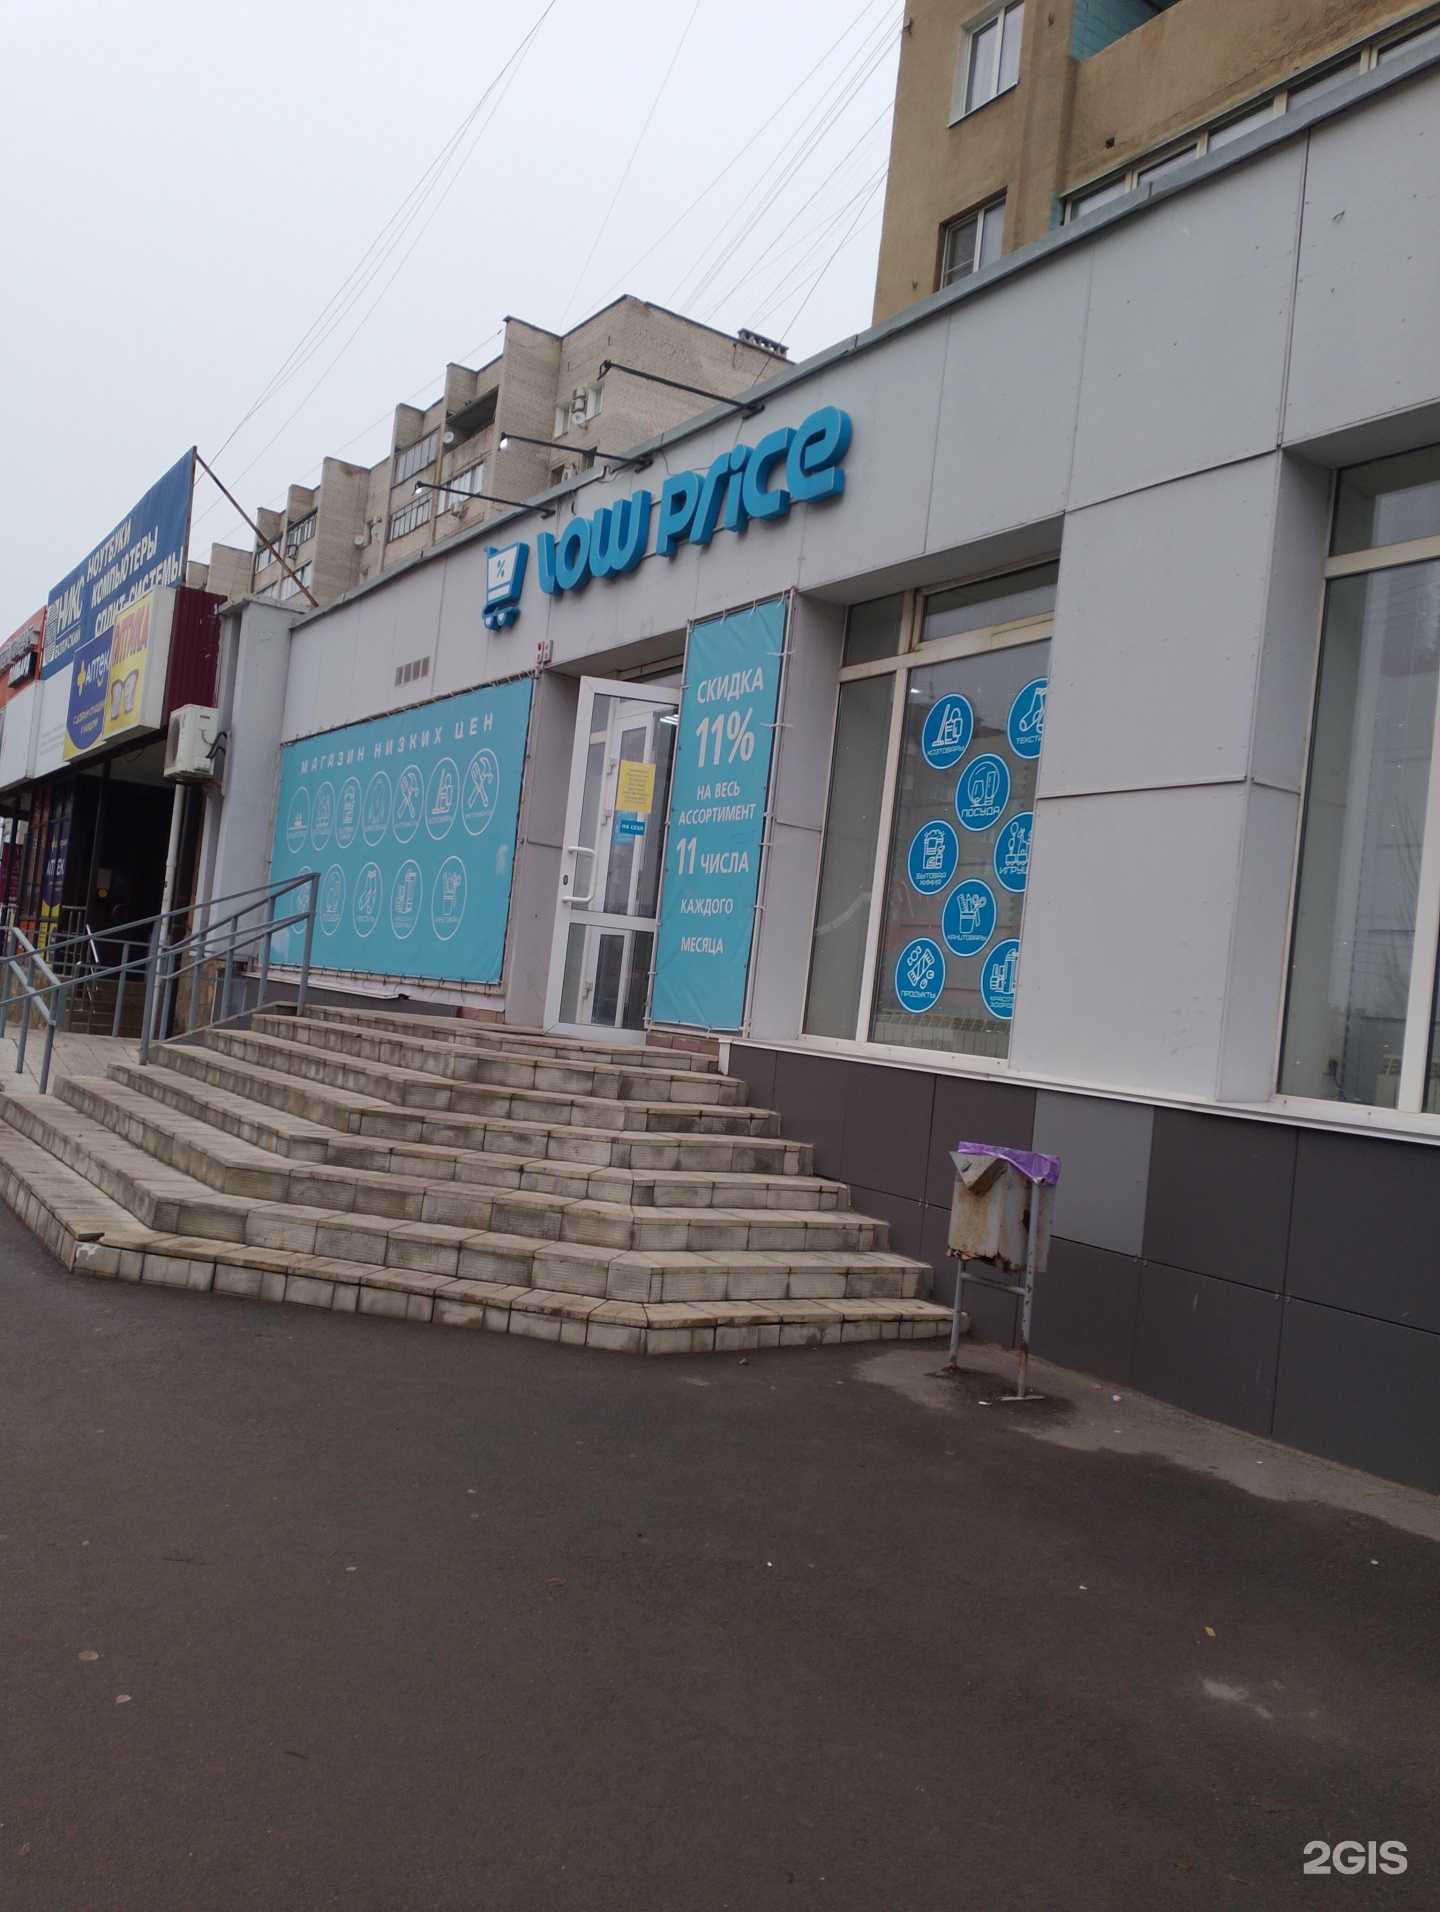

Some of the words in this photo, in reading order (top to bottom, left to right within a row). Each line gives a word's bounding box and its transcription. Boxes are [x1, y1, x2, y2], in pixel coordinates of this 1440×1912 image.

[92, 525, 159, 609] КОМПЬЮТЕРЫ
[697, 666, 765, 704] СКИДКА
[301, 747, 366, 774] МАГАЗИН
[374, 727, 443, 759] НИЗКИХ
[455, 712, 494, 739] ЦЕН
[695, 708, 755, 769] 11%
[1016, 734, 1041, 745] ТЕКСТ
[697, 785, 711, 800] НА
[714, 782, 740, 798] ВЕСЬ
[678, 803, 757, 826] АССОРТИМЕНТ
[961, 805, 1000, 818] ПОСУДА
[676, 837, 697, 876] 11
[700, 852, 749, 875] ЧИСЛА
[680, 898, 734, 916] КАЖДОГО
[680, 937, 724, 954] МЕСЯЦА
